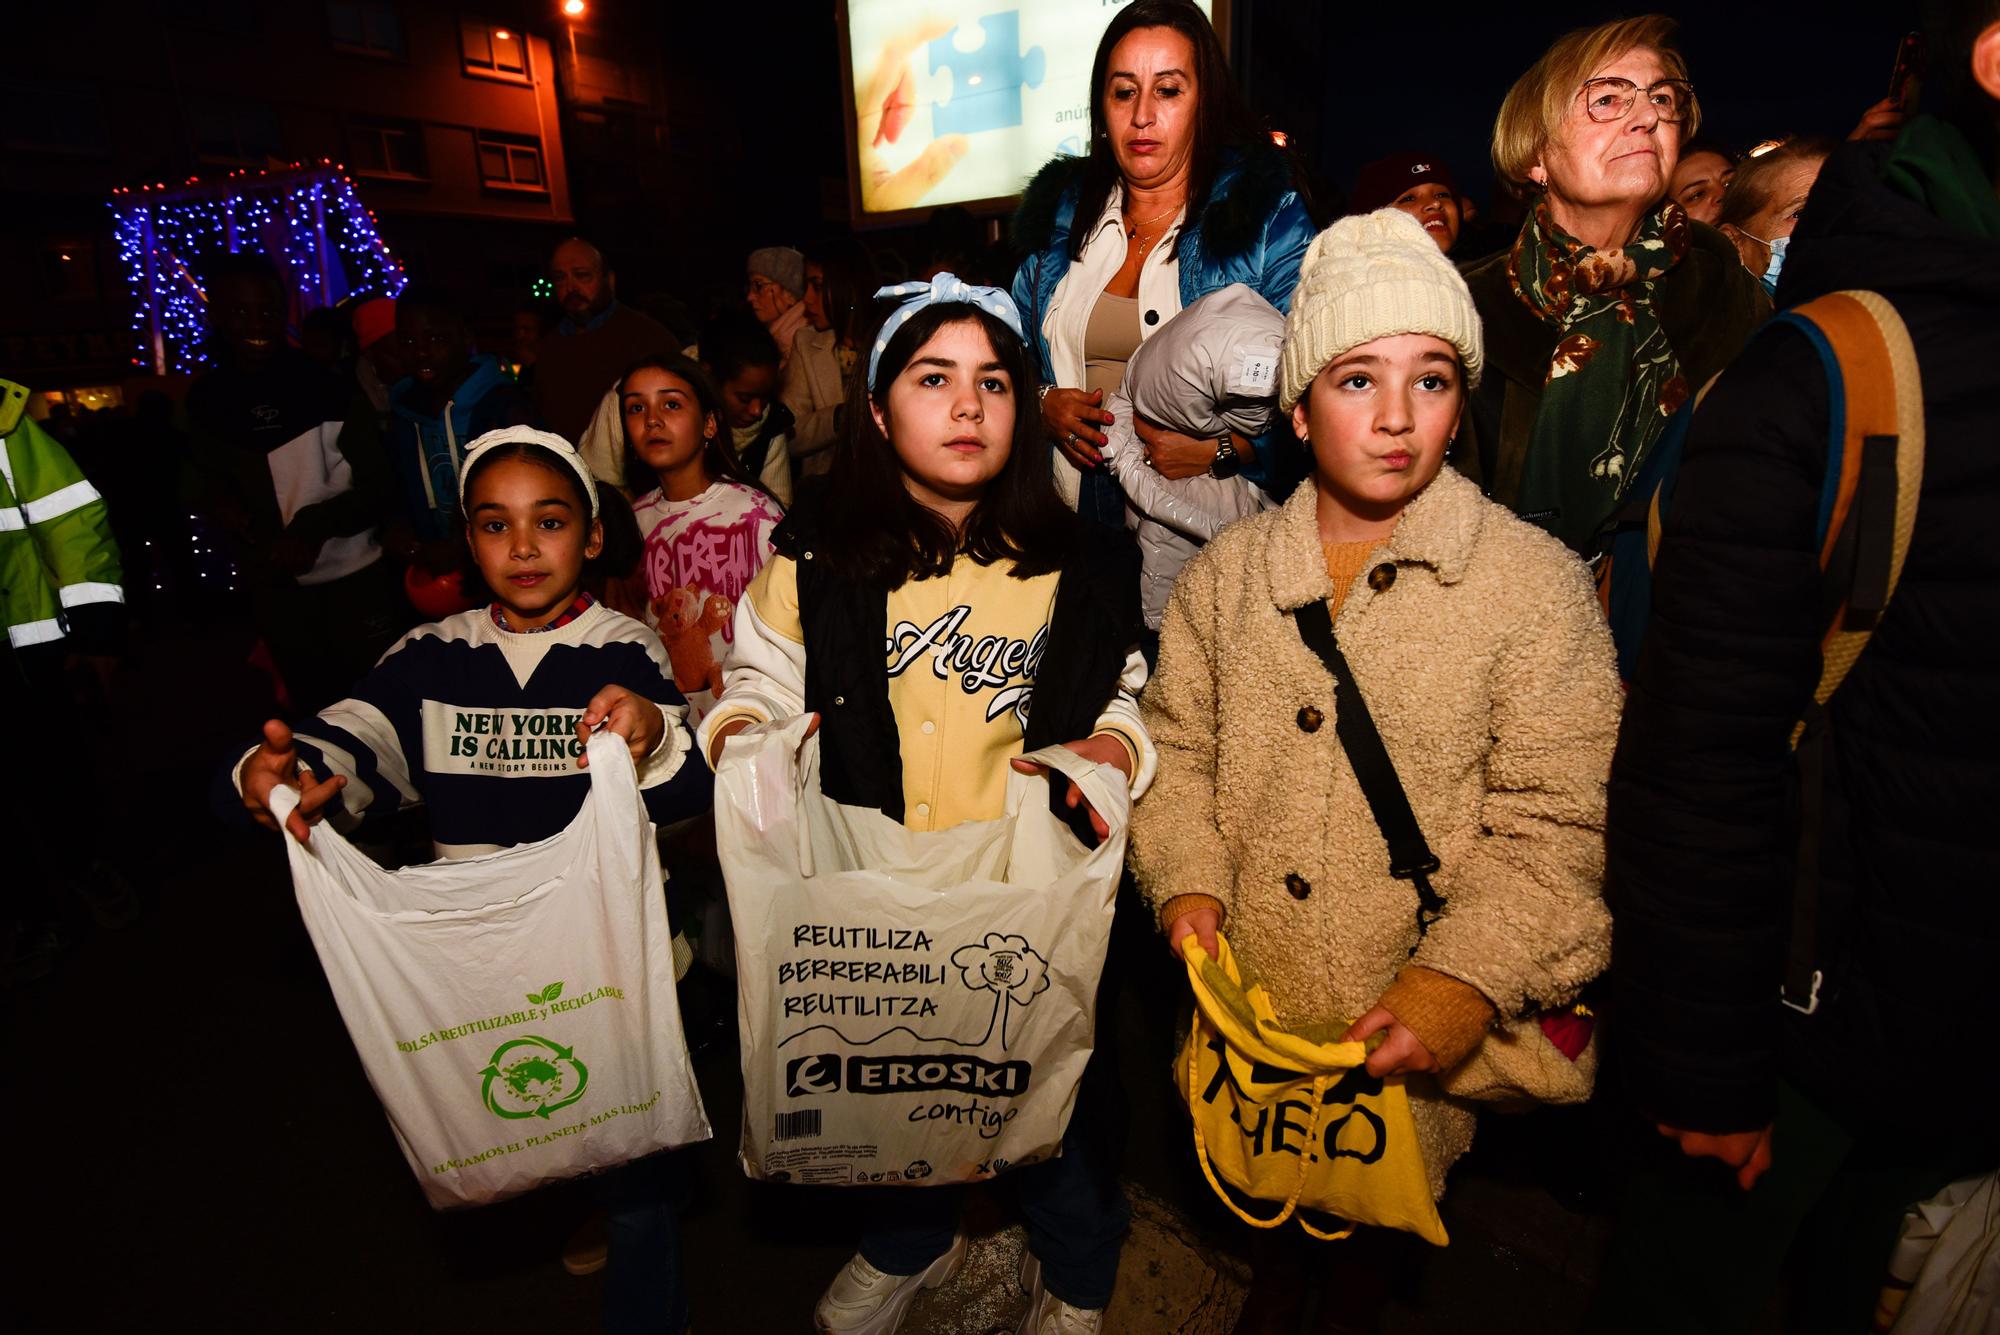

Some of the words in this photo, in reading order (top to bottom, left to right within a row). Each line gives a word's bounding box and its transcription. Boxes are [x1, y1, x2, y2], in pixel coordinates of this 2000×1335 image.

[455, 712, 505, 736] NEW
[511, 713, 583, 736] YORK
[450, 735, 479, 757] IS
[486, 738, 587, 760] CALLING
[470, 761, 475, 769] A
[480, 762, 494, 770] NEW
[498, 763, 526, 772] STORY
[532, 763, 567, 771] BEGINS
[793, 924, 933, 951] REUTILIZA
[778, 959, 946, 985] BERRERABILI
[784, 993, 939, 1018] REUTILITZA
[396, 1032, 438, 1053] BOLSA
[439, 1008, 538, 1041] REUTILIZABLE
[540, 1008, 548, 1021] y
[550, 986, 625, 1014] RECICLABLE
[860, 1062, 1017, 1091] EROSKI
[908, 1098, 1018, 1139] contigo
[434, 1146, 505, 1174] HAGAMOS
[507, 1142, 524, 1153] EL
[526, 1122, 587, 1147] PLANETA
[590, 1107, 619, 1126] MAS
[621, 1091, 661, 1115] LIMPIO
